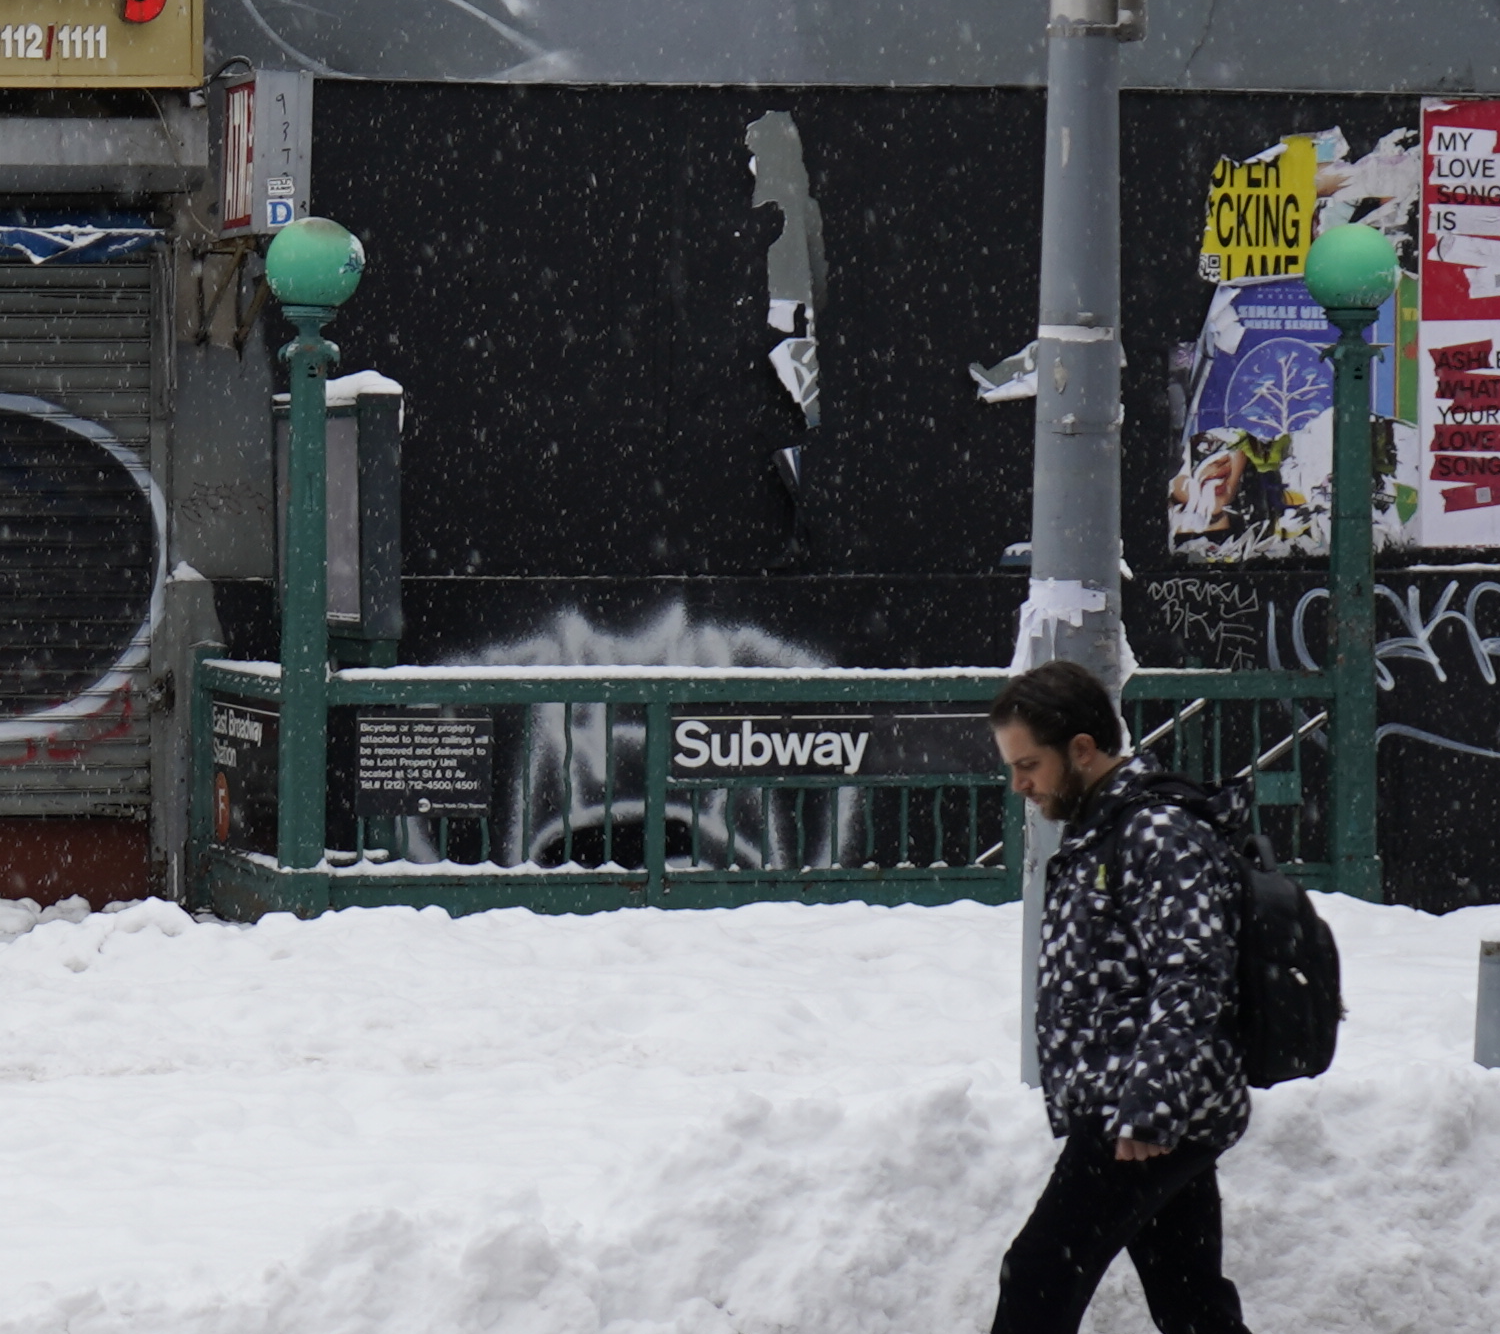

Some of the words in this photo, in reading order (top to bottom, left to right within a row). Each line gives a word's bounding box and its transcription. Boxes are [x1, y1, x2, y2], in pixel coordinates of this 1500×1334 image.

[1437, 132, 1473, 151] MY
[1437, 158, 1496, 178] LOVE
[268, 201, 293, 225] D
[1436, 211, 1457, 231] IS
[1437, 405, 1500, 425] YOUR
[1437, 430, 1496, 451] LOVE
[212, 706, 227, 735] East
[228, 711, 263, 748] Broadway
[360, 723, 397, 734] Bicycles
[438, 723, 476, 734] property
[360, 735, 400, 745] attached
[402, 735, 411, 745] to
[414, 735, 439, 745] these
[441, 735, 473, 745] railings
[673, 720, 869, 774] Subway
[212, 737, 237, 767] Station
[360, 747, 372, 756] be
[374, 747, 413, 756] removed
[415, 747, 432, 756] and
[434, 747, 474, 756] delivered
[476, 747, 487, 756] to
[360, 758, 374, 768] the
[376, 758, 397, 768] Lost
[400, 758, 438, 768] Property
[440, 758, 457, 768] Unit
[360, 769, 393, 779] located
[422, 769, 433, 779] St
[218, 787, 226, 824] F
